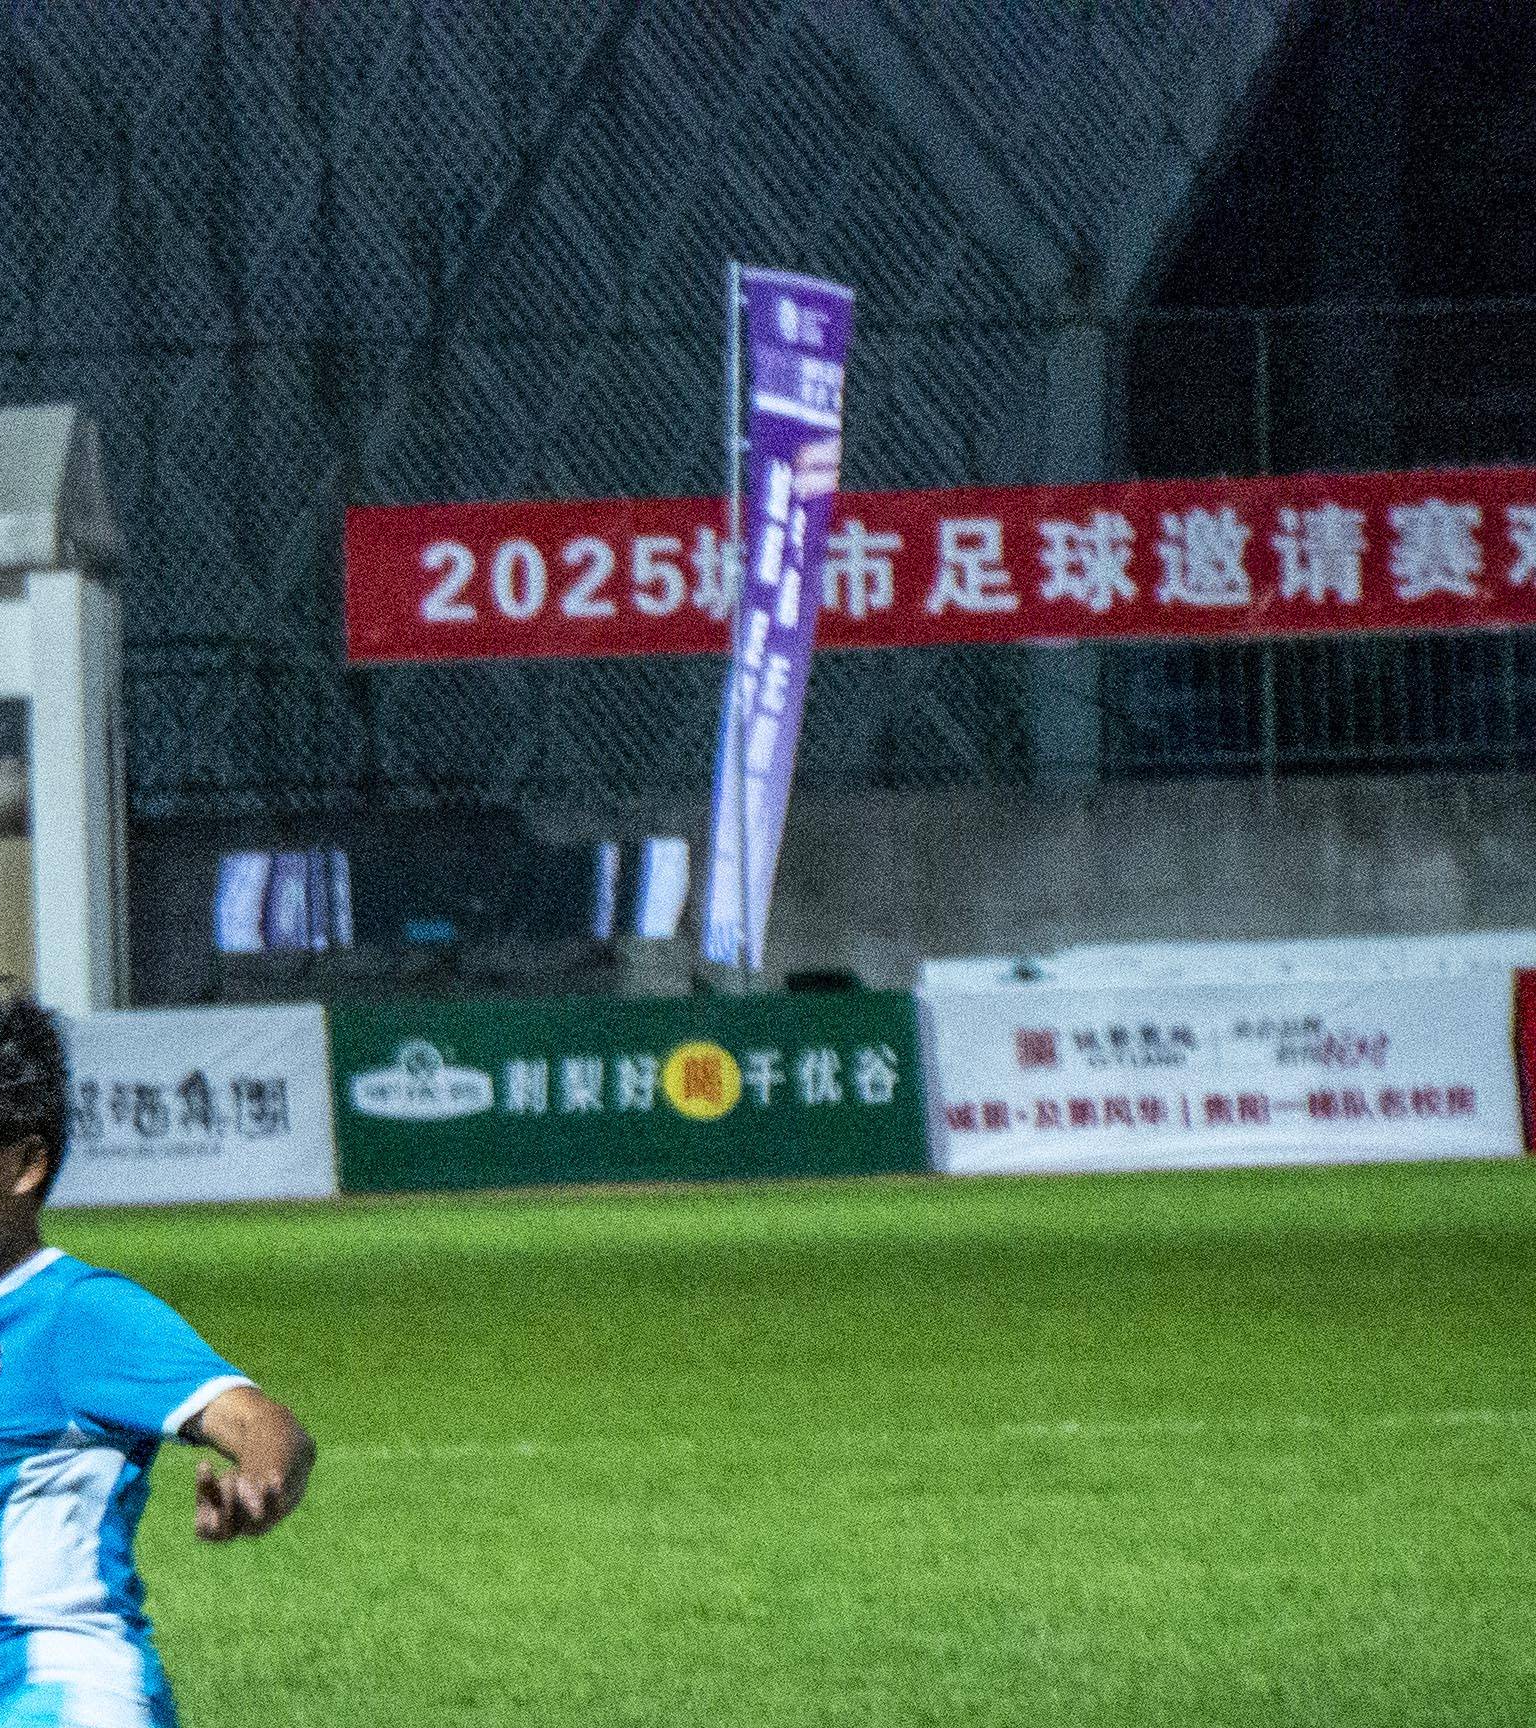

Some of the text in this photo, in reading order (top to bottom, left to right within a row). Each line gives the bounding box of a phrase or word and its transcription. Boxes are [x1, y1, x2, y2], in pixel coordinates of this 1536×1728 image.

[419, 496, 1536, 623] 2025市足球邀请赛
